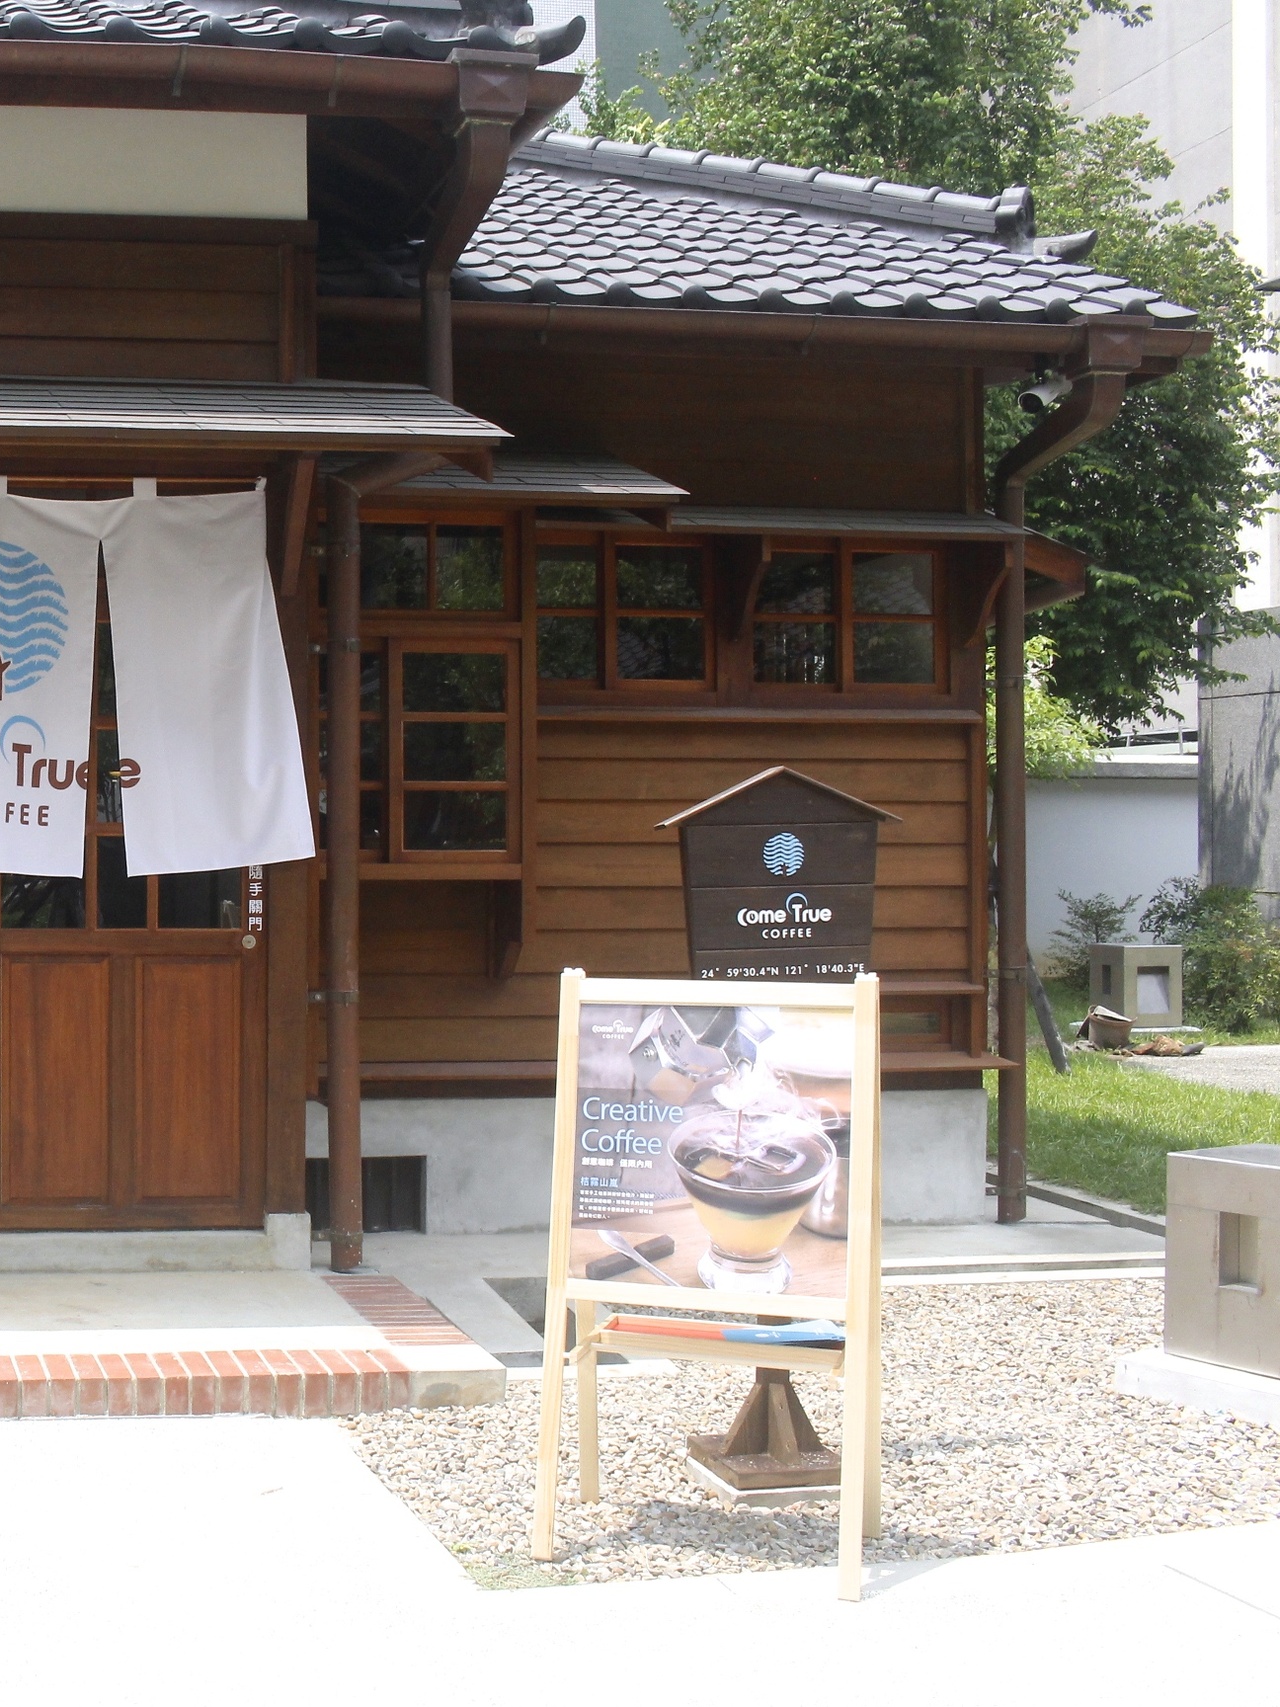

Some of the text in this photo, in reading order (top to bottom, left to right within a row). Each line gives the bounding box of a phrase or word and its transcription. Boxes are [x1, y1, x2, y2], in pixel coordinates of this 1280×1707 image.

[737, 903, 833, 927] Come True
[762, 927, 812, 939] COFFEE
[592, 1023, 634, 1034] Come True
[583, 1096, 684, 1124] Creative
[581, 1128, 663, 1156] Coffee
